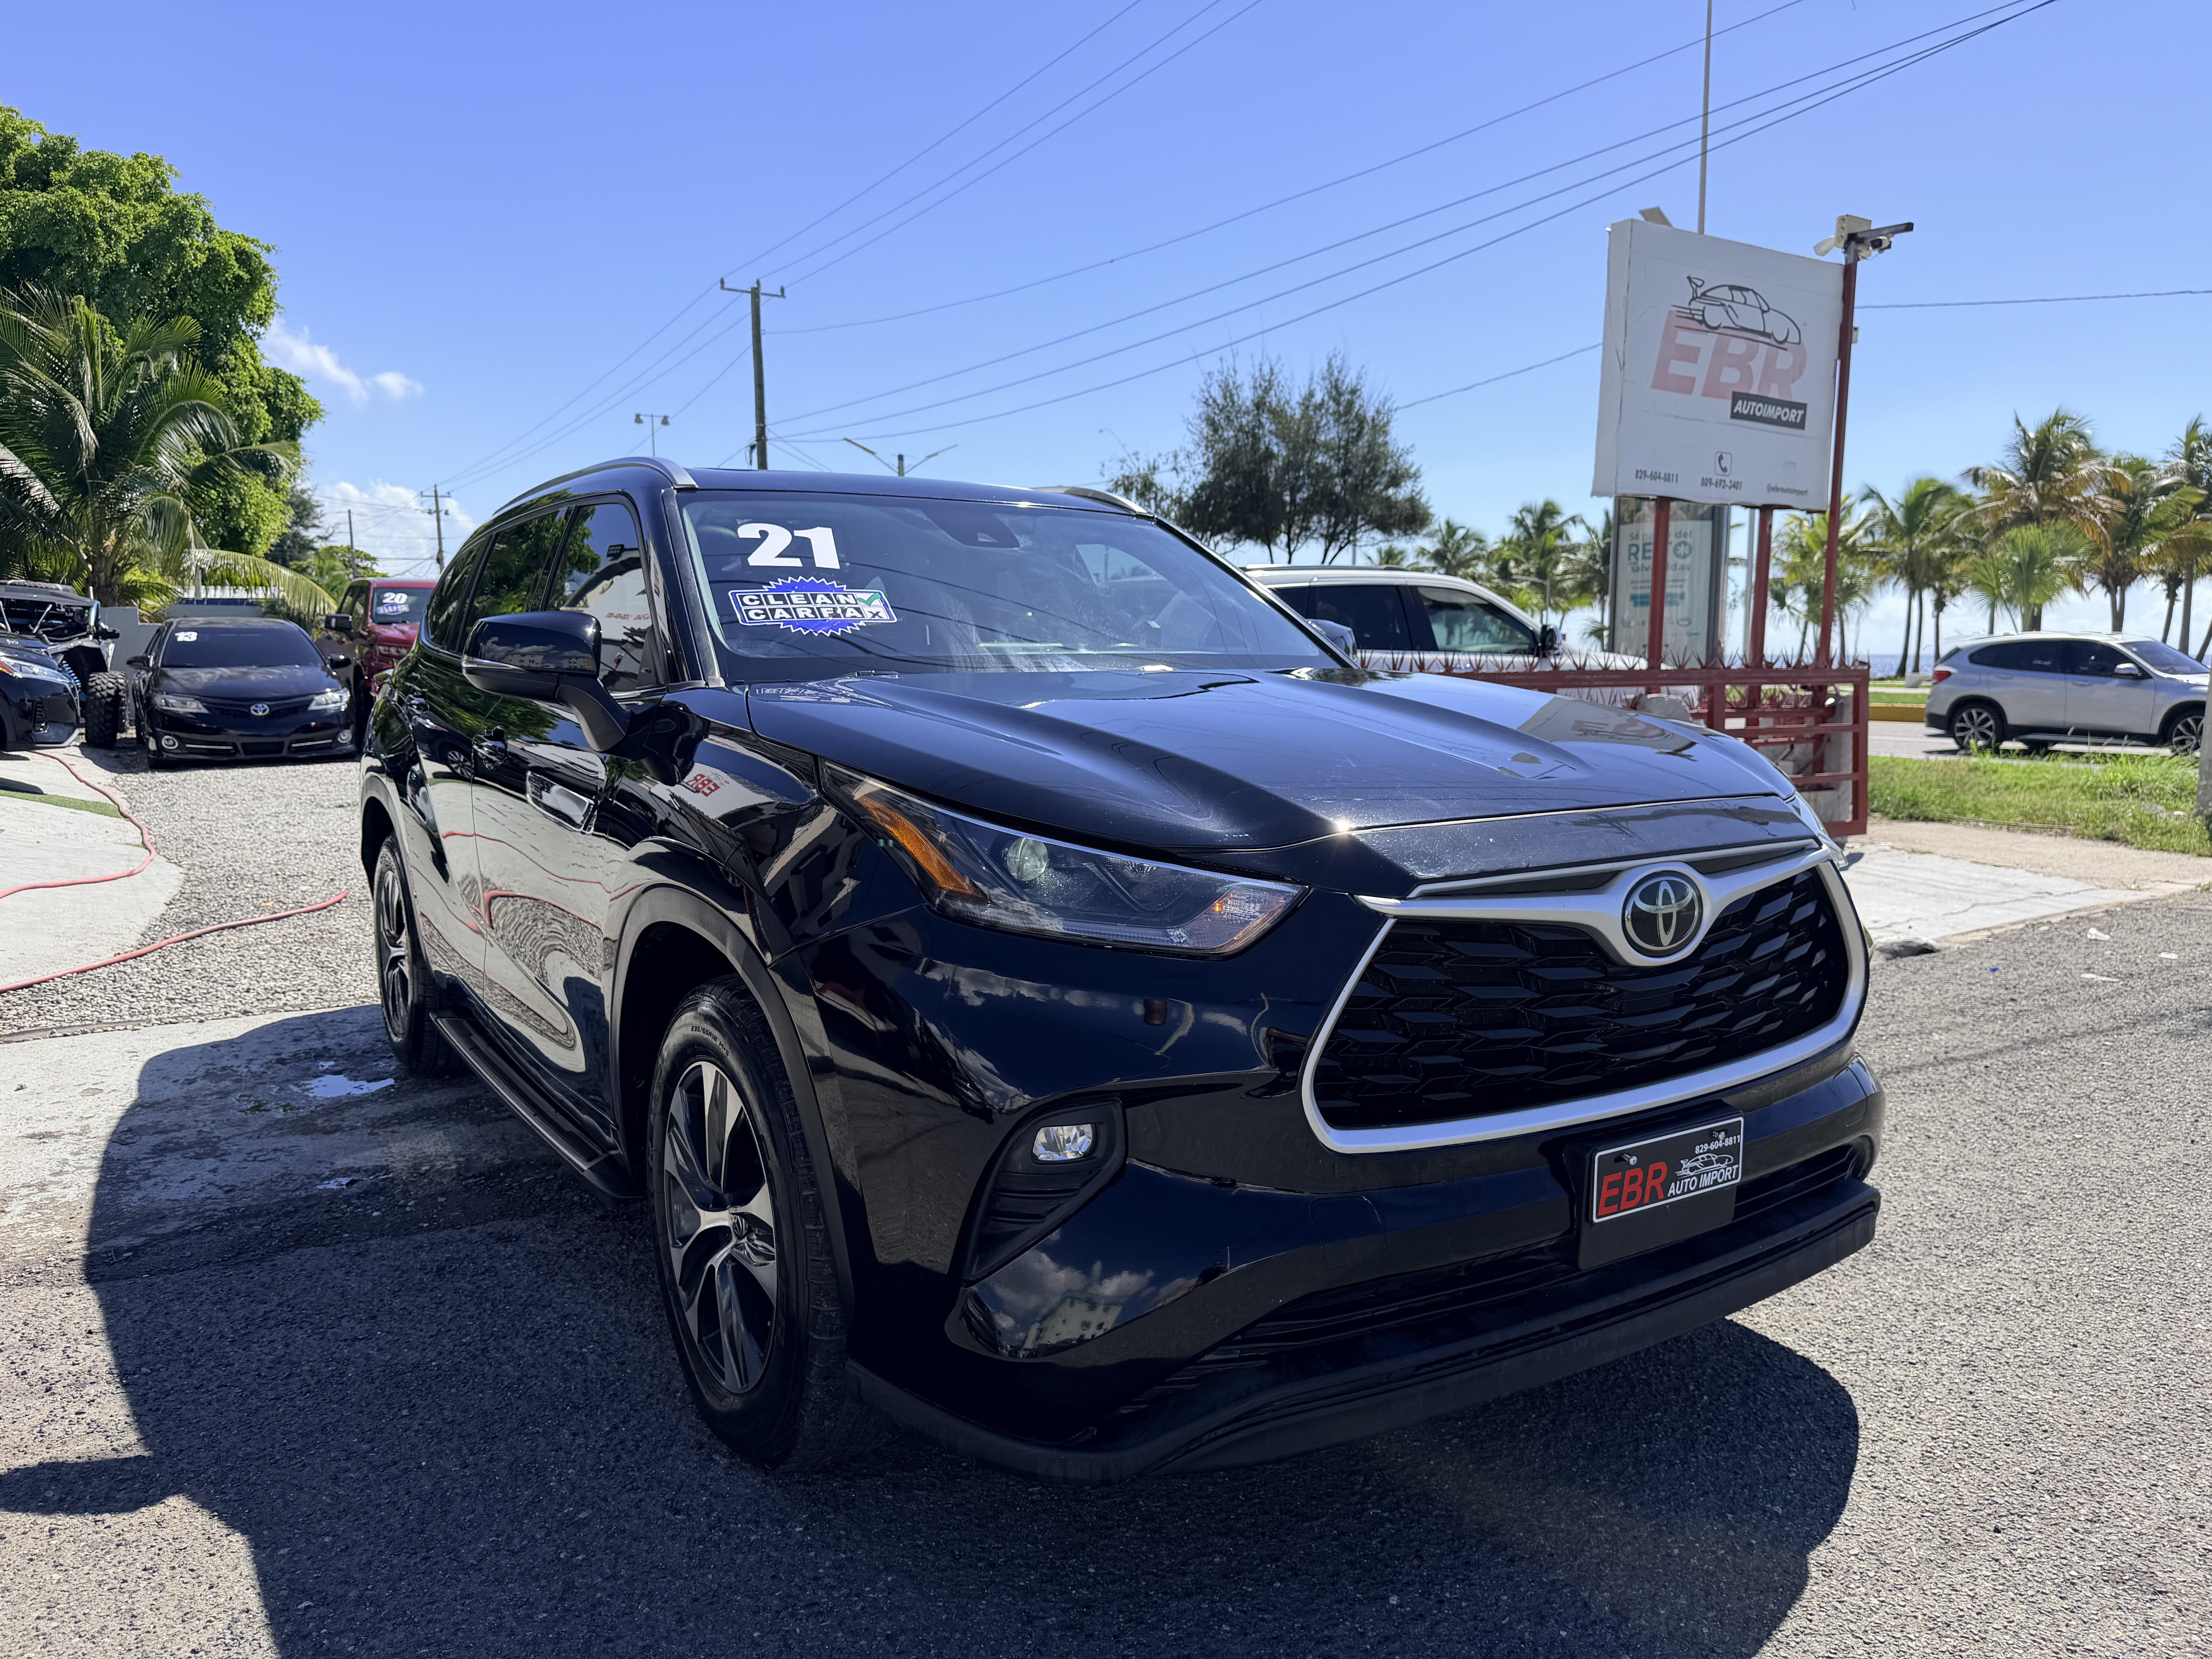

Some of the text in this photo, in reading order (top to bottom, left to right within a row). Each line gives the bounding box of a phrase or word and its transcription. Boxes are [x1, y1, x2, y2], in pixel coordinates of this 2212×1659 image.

[1650, 310, 1807, 401] EBR
[1733, 399, 1805, 423] AUTOIMPORT
[1635, 469, 1678, 484] 829-604-8811
[1674, 529, 1692, 539] del
[737, 523, 840, 569] 21
[1628, 541, 1692, 562] REO
[382, 592, 408, 604] 20
[742, 593, 858, 605] CLEAN
[748, 607, 887, 620] CARFAX
[691, 1025, 717, 1042] 235/65R18
[1695, 1135, 1740, 1154] 829-604-8811
[1598, 1161, 1667, 1216] EBR
[1668, 1164, 1739, 1197] AUTO IMPORT
